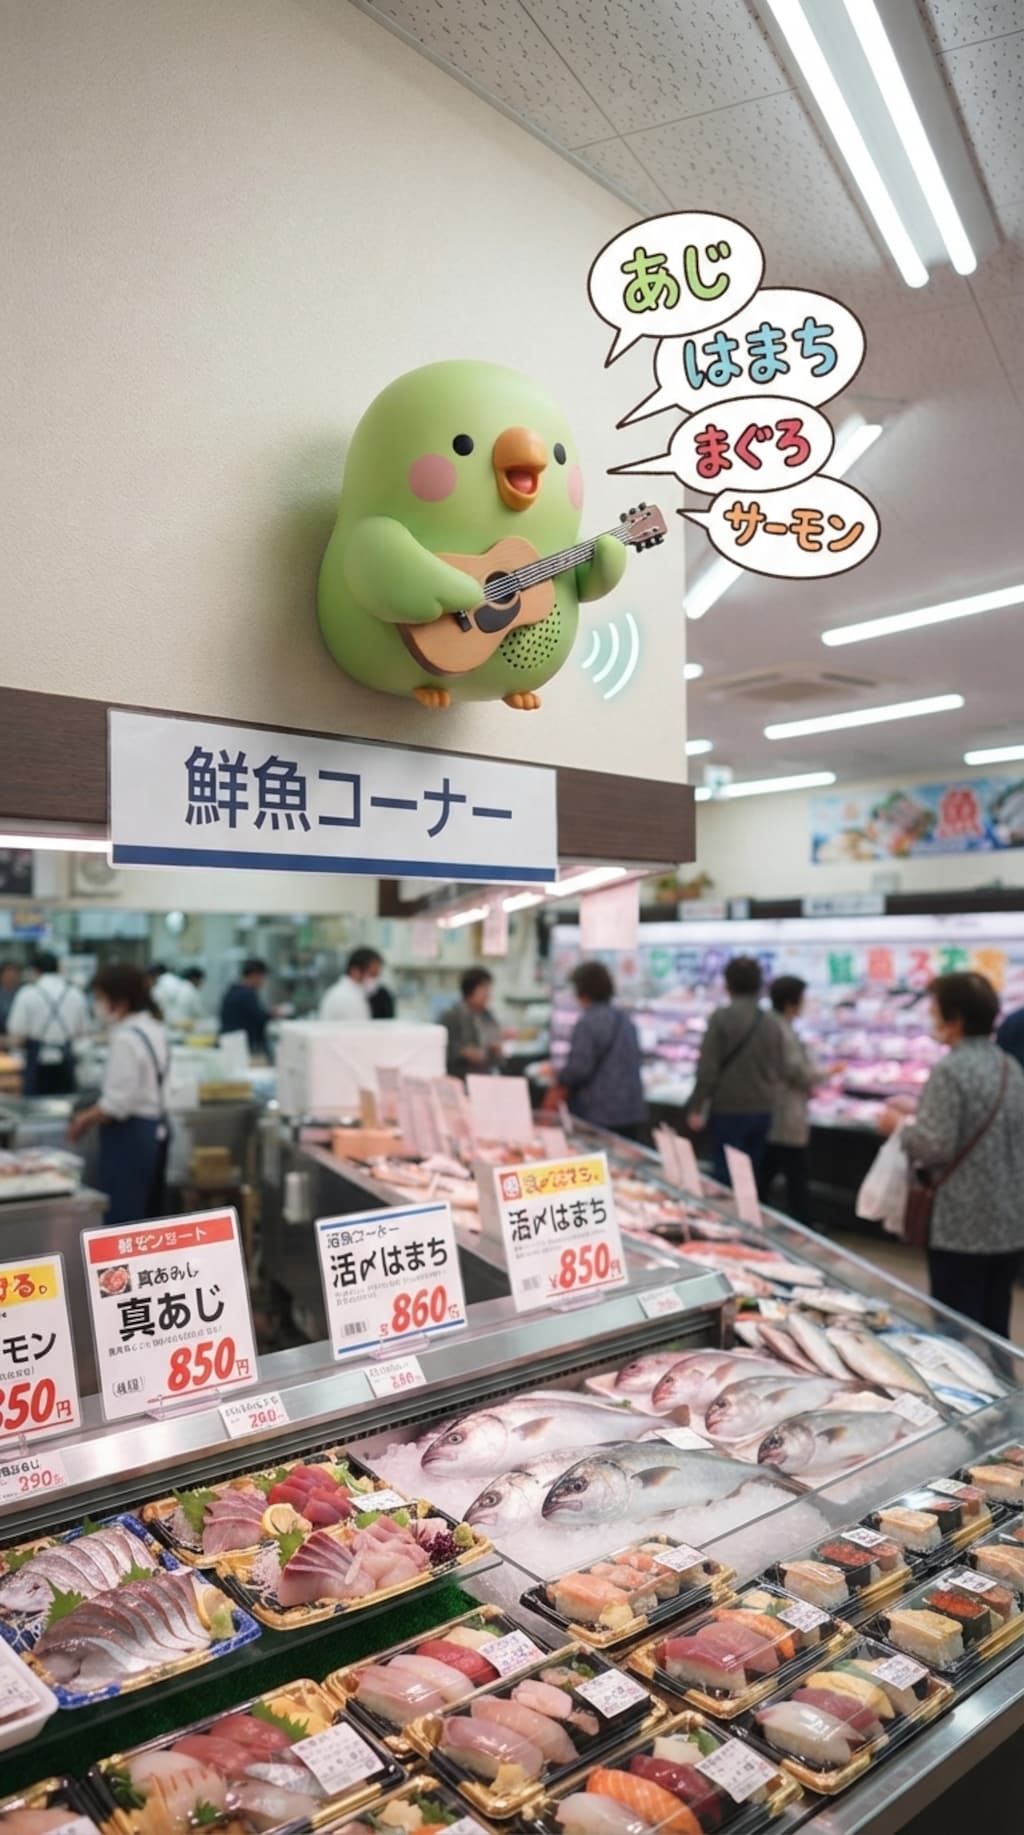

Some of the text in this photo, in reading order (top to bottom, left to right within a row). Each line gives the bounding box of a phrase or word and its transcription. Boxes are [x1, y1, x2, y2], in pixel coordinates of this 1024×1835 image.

[184, 745, 513, 838] 鮮魚コーナー
[330, 1236, 448, 1289] 活〆はまち
[117, 1284, 225, 1342] 真あじ
